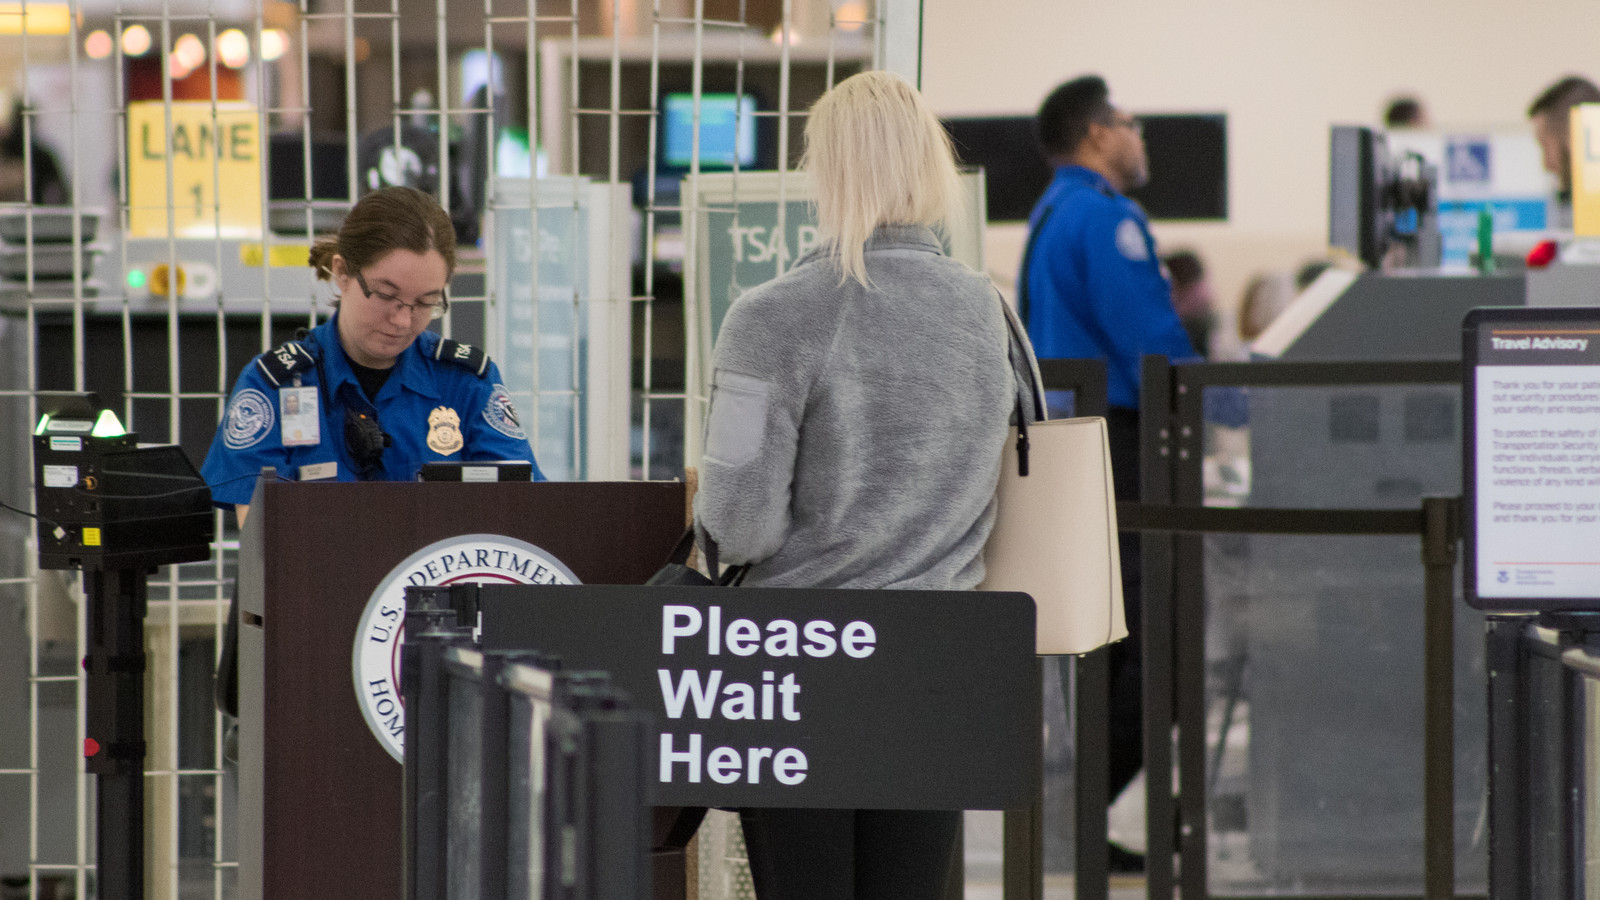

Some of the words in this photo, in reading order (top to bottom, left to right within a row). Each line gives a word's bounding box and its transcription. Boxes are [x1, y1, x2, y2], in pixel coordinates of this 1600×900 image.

[141, 119, 254, 161] LANE
[190, 181, 203, 219] 1
[728, 226, 791, 262] TSA
[273, 345, 297, 370] TSA
[454, 343, 472, 359] TSA
[1491, 337, 1531, 350] Travel
[1532, 337, 1588, 352] Advisory
[370, 605, 403, 643] U.S.
[661, 604, 877, 659] Please
[657, 668, 802, 722] Wait
[659, 733, 809, 786] Here
